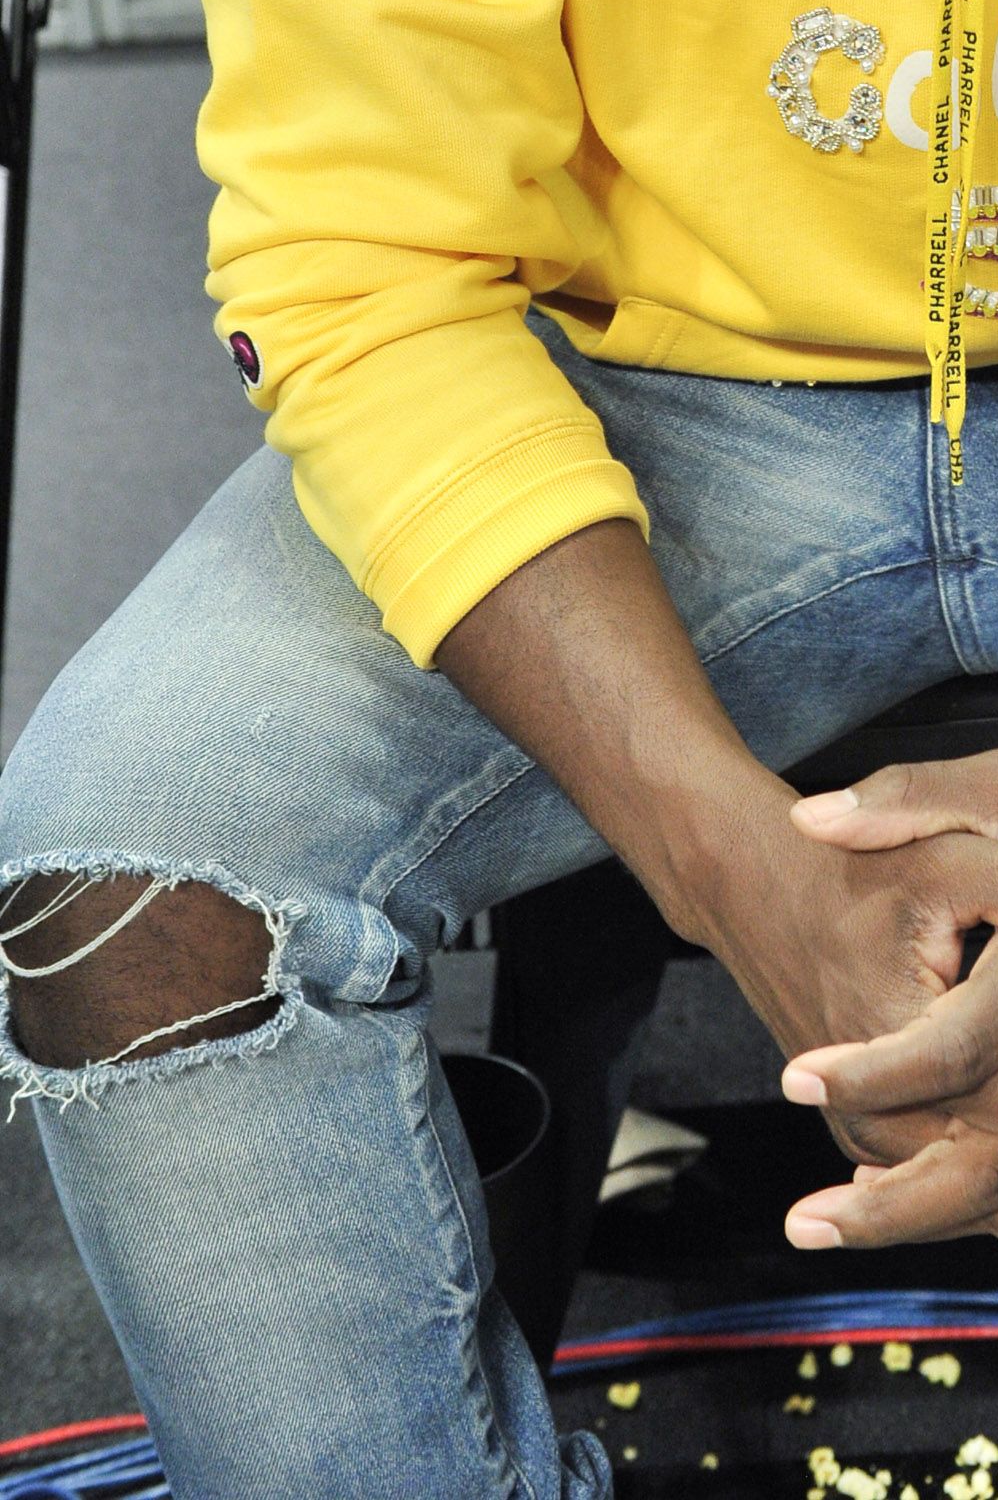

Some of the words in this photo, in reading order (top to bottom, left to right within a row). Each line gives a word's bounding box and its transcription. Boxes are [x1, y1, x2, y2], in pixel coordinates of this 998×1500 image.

[932, 94, 950, 184] CHANEL
[958, 30, 978, 148] PHARRELL
[927, 211, 948, 324] PHARRELL
[944, 290, 965, 409] PHARRELL
